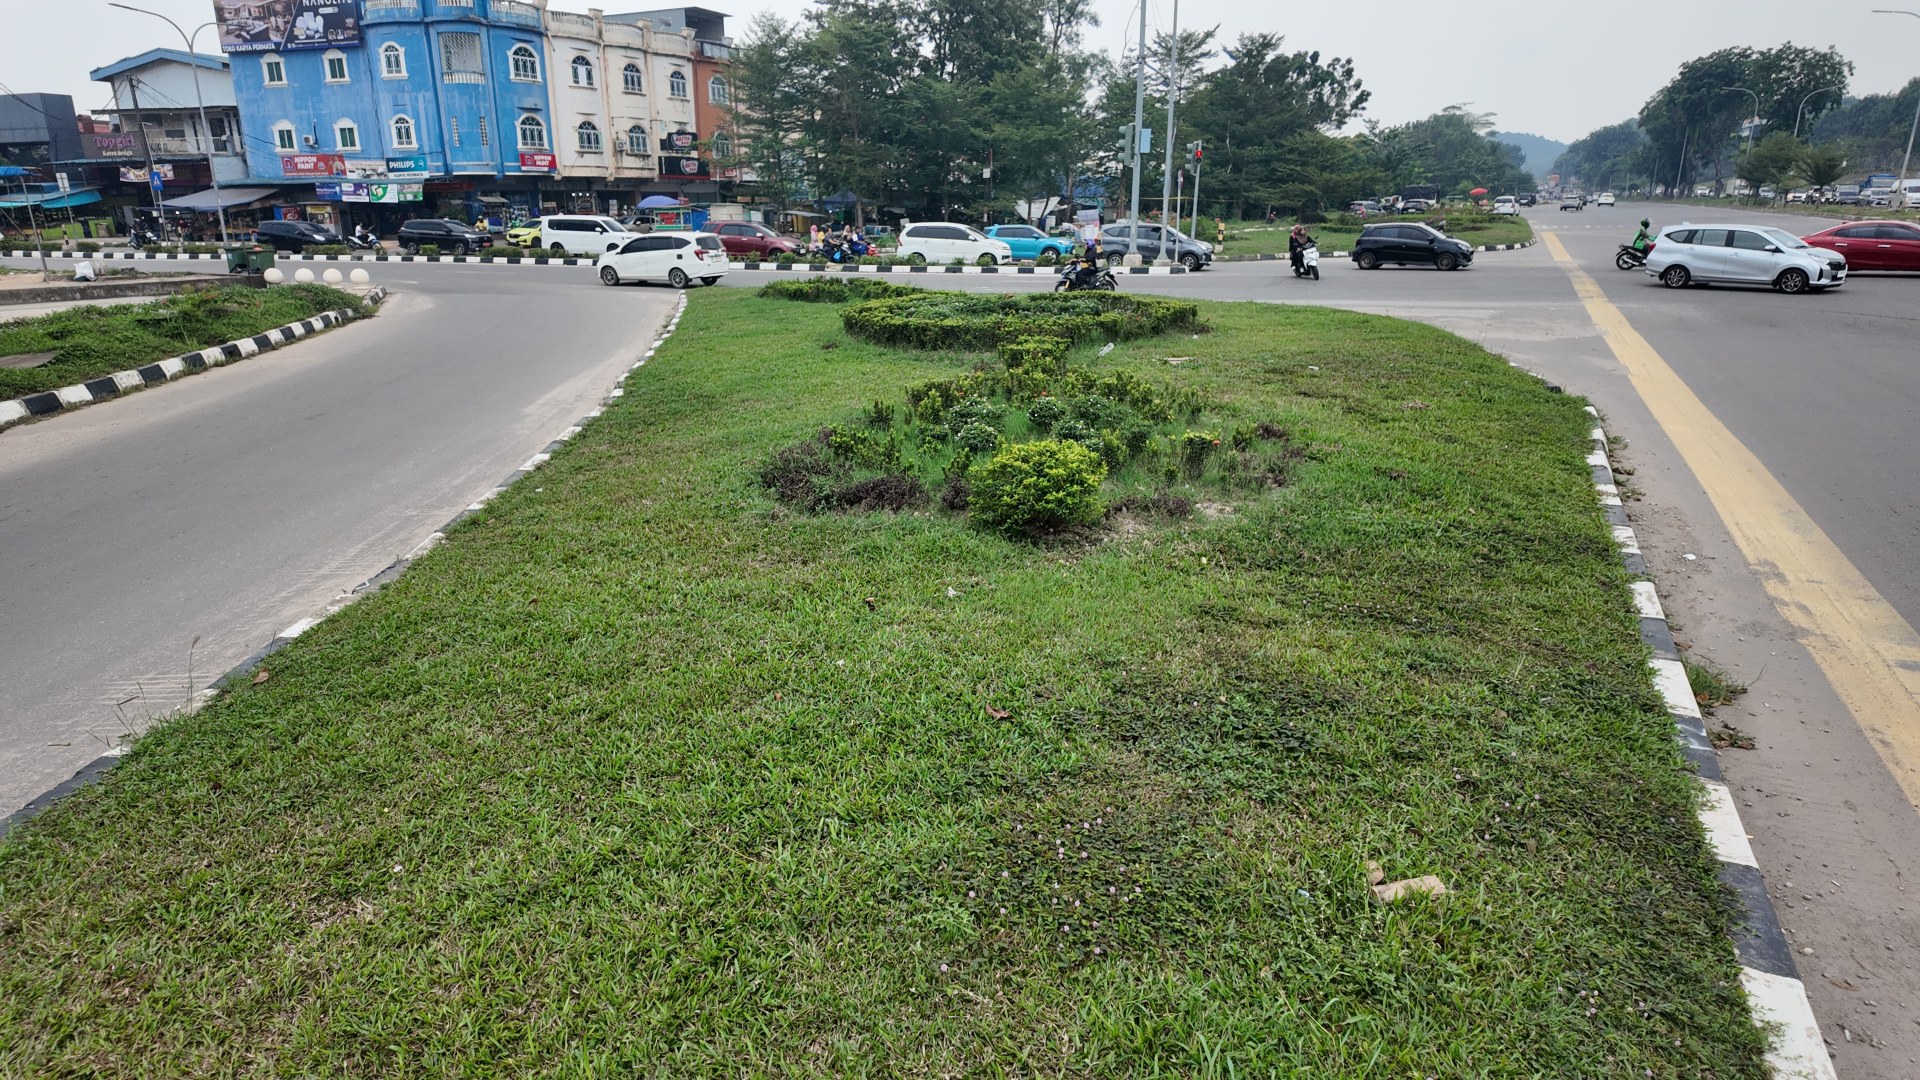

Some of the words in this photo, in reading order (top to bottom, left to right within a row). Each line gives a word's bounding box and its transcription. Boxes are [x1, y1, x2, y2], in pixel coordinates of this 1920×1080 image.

[236, 43, 252, 51] KARYA
[252, 42, 275, 50] PERMATA
[94, 136, 115, 148] Top
[116, 135, 135, 149] girl
[297, 162, 315, 170] PAINT
[389, 161, 415, 169] PHILIPS
